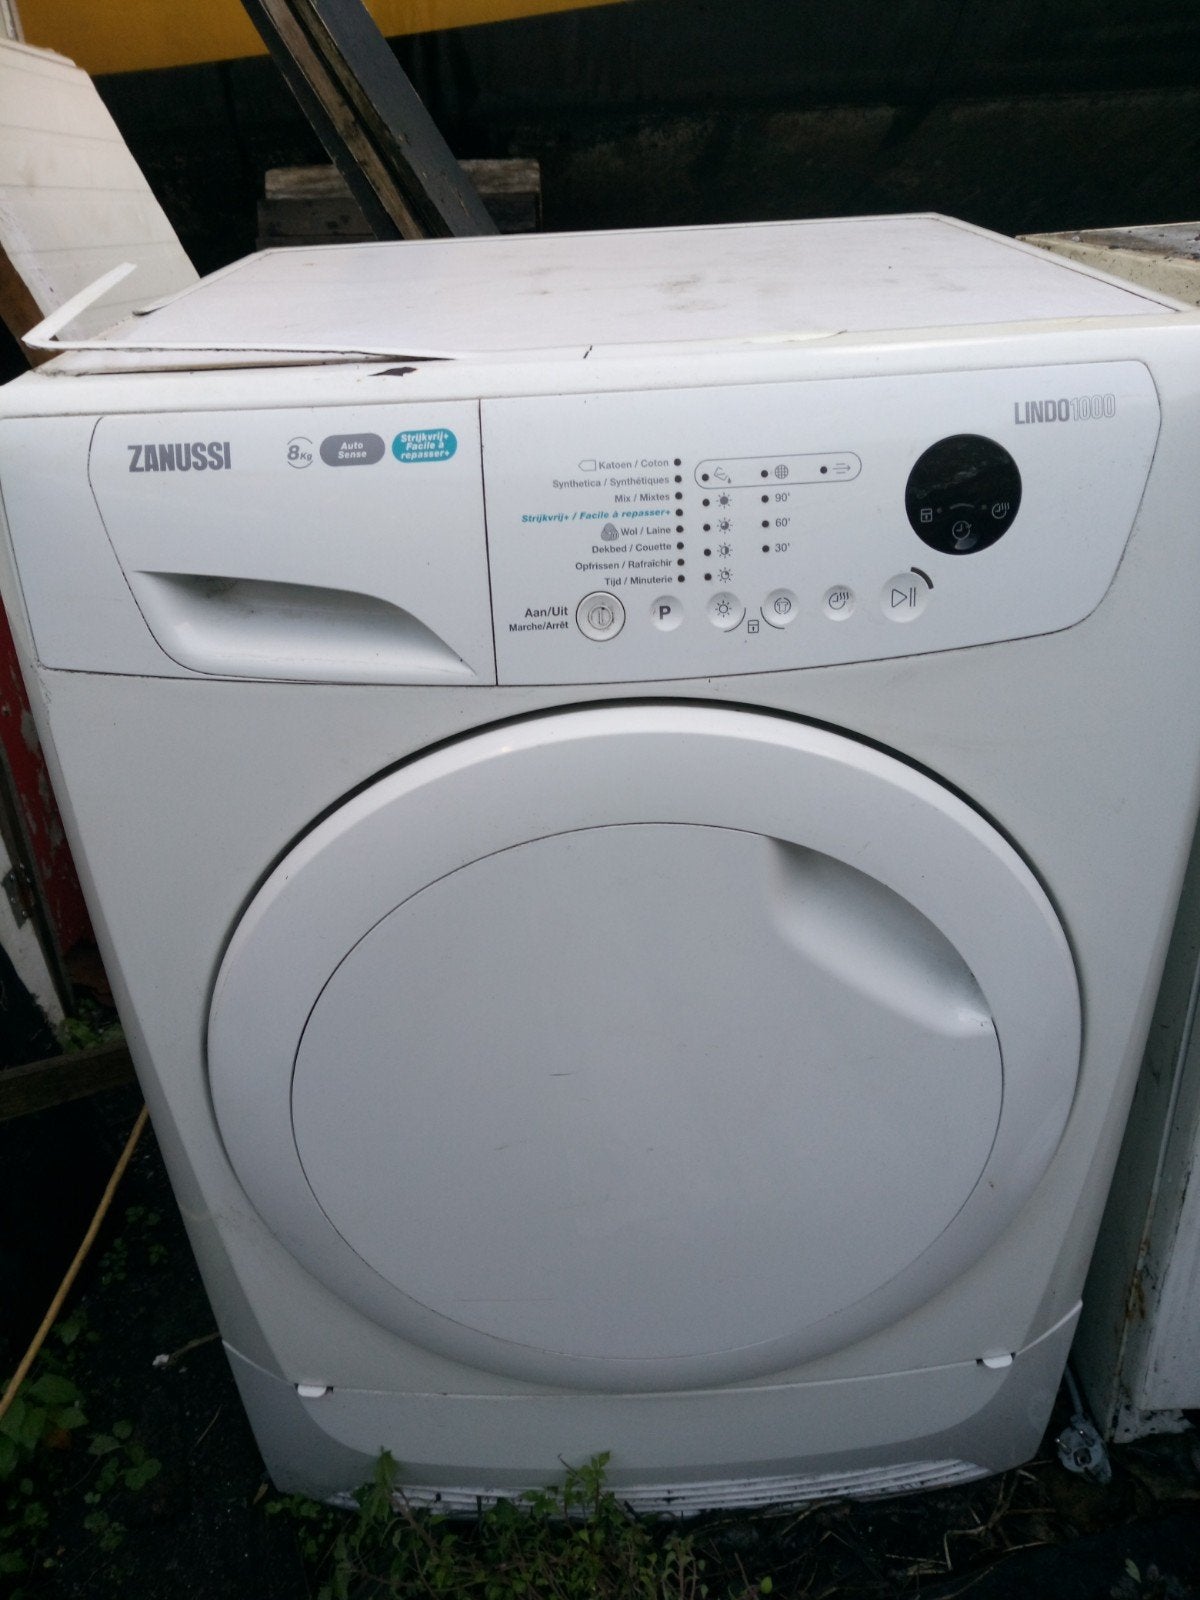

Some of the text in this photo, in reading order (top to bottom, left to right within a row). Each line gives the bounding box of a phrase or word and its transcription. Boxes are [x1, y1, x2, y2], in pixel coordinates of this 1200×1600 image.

[340, 441, 364, 450] Auto
[405, 442, 436, 451] Facile
[127, 441, 232, 472] ZANUSSI
[337, 450, 367, 459] Sense
[400, 450, 450, 460] repasser+
[599, 461, 632, 470] Katoen
[641, 458, 669, 467] Coton
[552, 478, 601, 489] Synthetica
[610, 475, 670, 487] Synthétiques
[614, 494, 631, 503] Mix
[639, 492, 670, 502] Mixtes
[775, 492, 790, 502] 90'
[579, 511, 609, 520] Facile
[621, 508, 671, 519] repasser+
[775, 518, 791, 527] 60'
[620, 526, 638, 536] Wol
[646, 525, 671, 534] Laine
[592, 544, 627, 553] Dekbed
[635, 542, 672, 552] Couette
[775, 543, 790, 552] 30'
[575, 562, 620, 572] Opfrissen
[604, 577, 622, 587] Tijd
[630, 576, 673, 585] Minuterie
[525, 606, 568, 618] Aan/Uit
[659, 605, 671, 620] P
[509, 621, 569, 632] Marche/Arrêt
